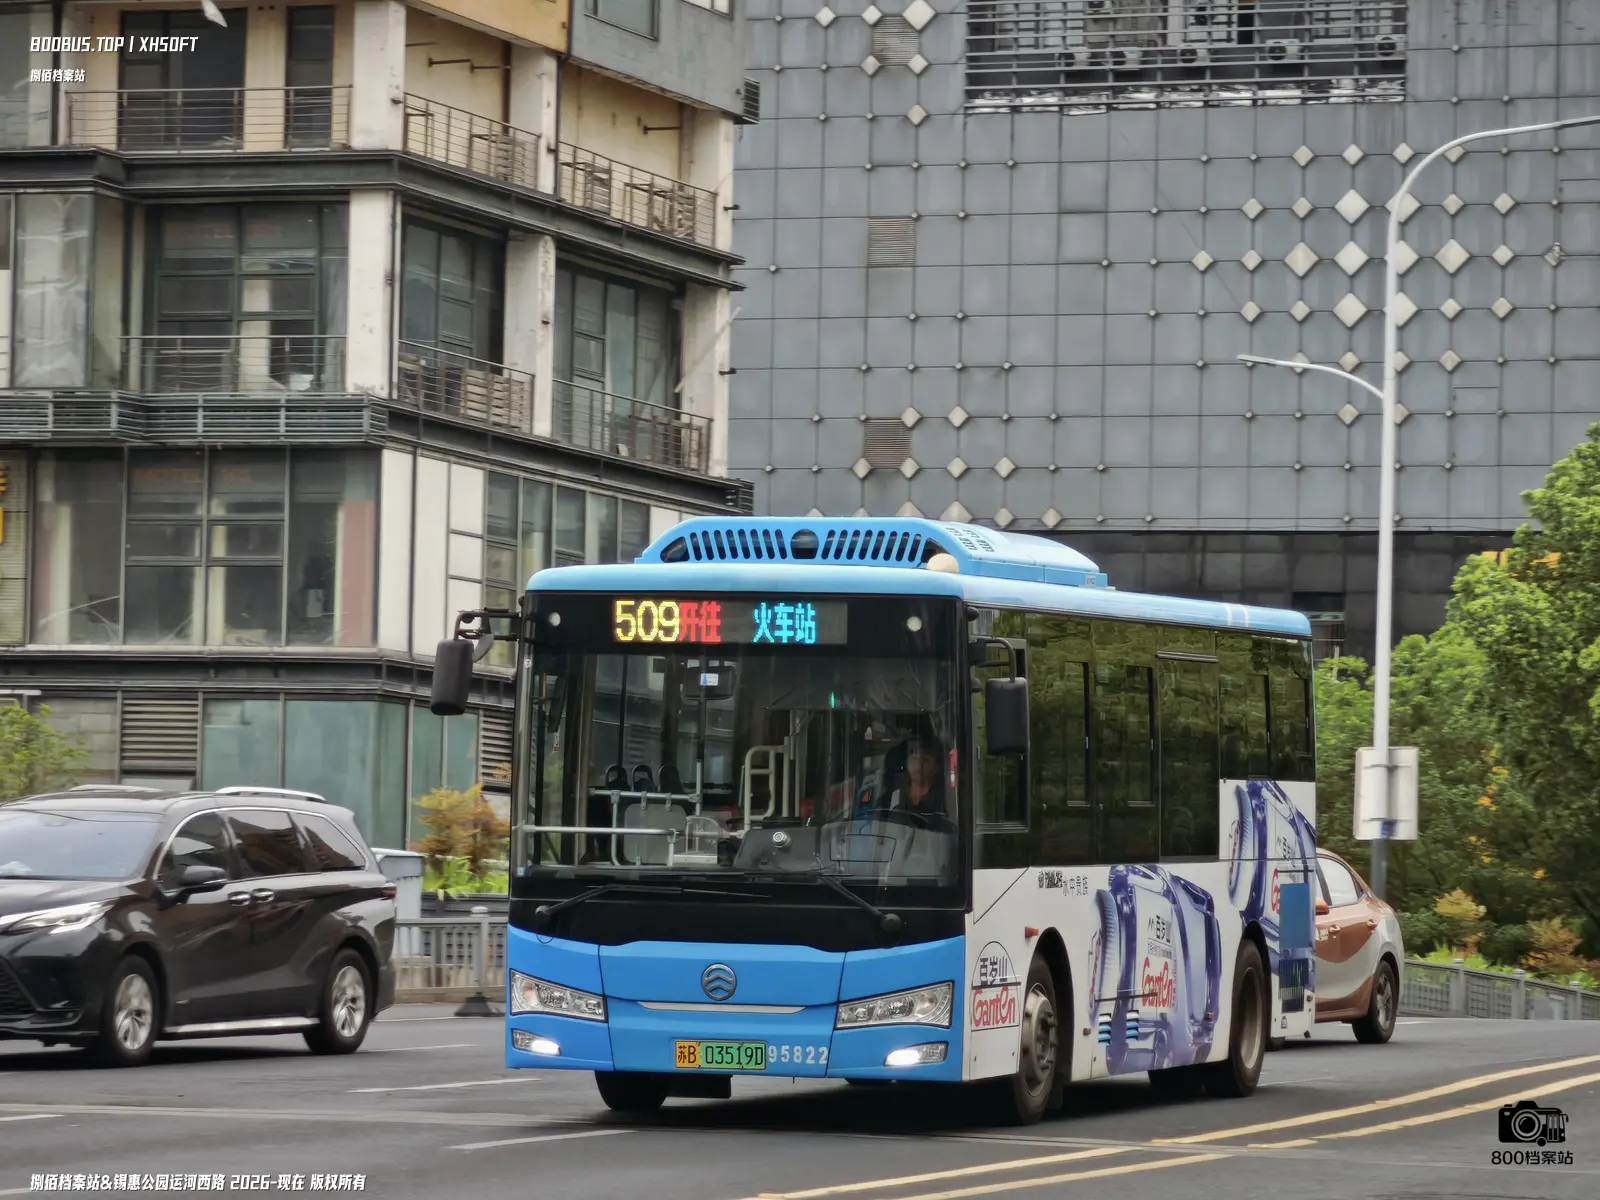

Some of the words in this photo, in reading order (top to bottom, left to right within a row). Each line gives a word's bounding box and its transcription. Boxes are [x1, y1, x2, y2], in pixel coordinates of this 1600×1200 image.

[615, 600, 680, 642] 509
[680, 601, 721, 643] 开往
[753, 603, 816, 643] 火车站
[980, 956, 1008, 986] 百岁山
[768, 1045, 828, 1065] 95822
